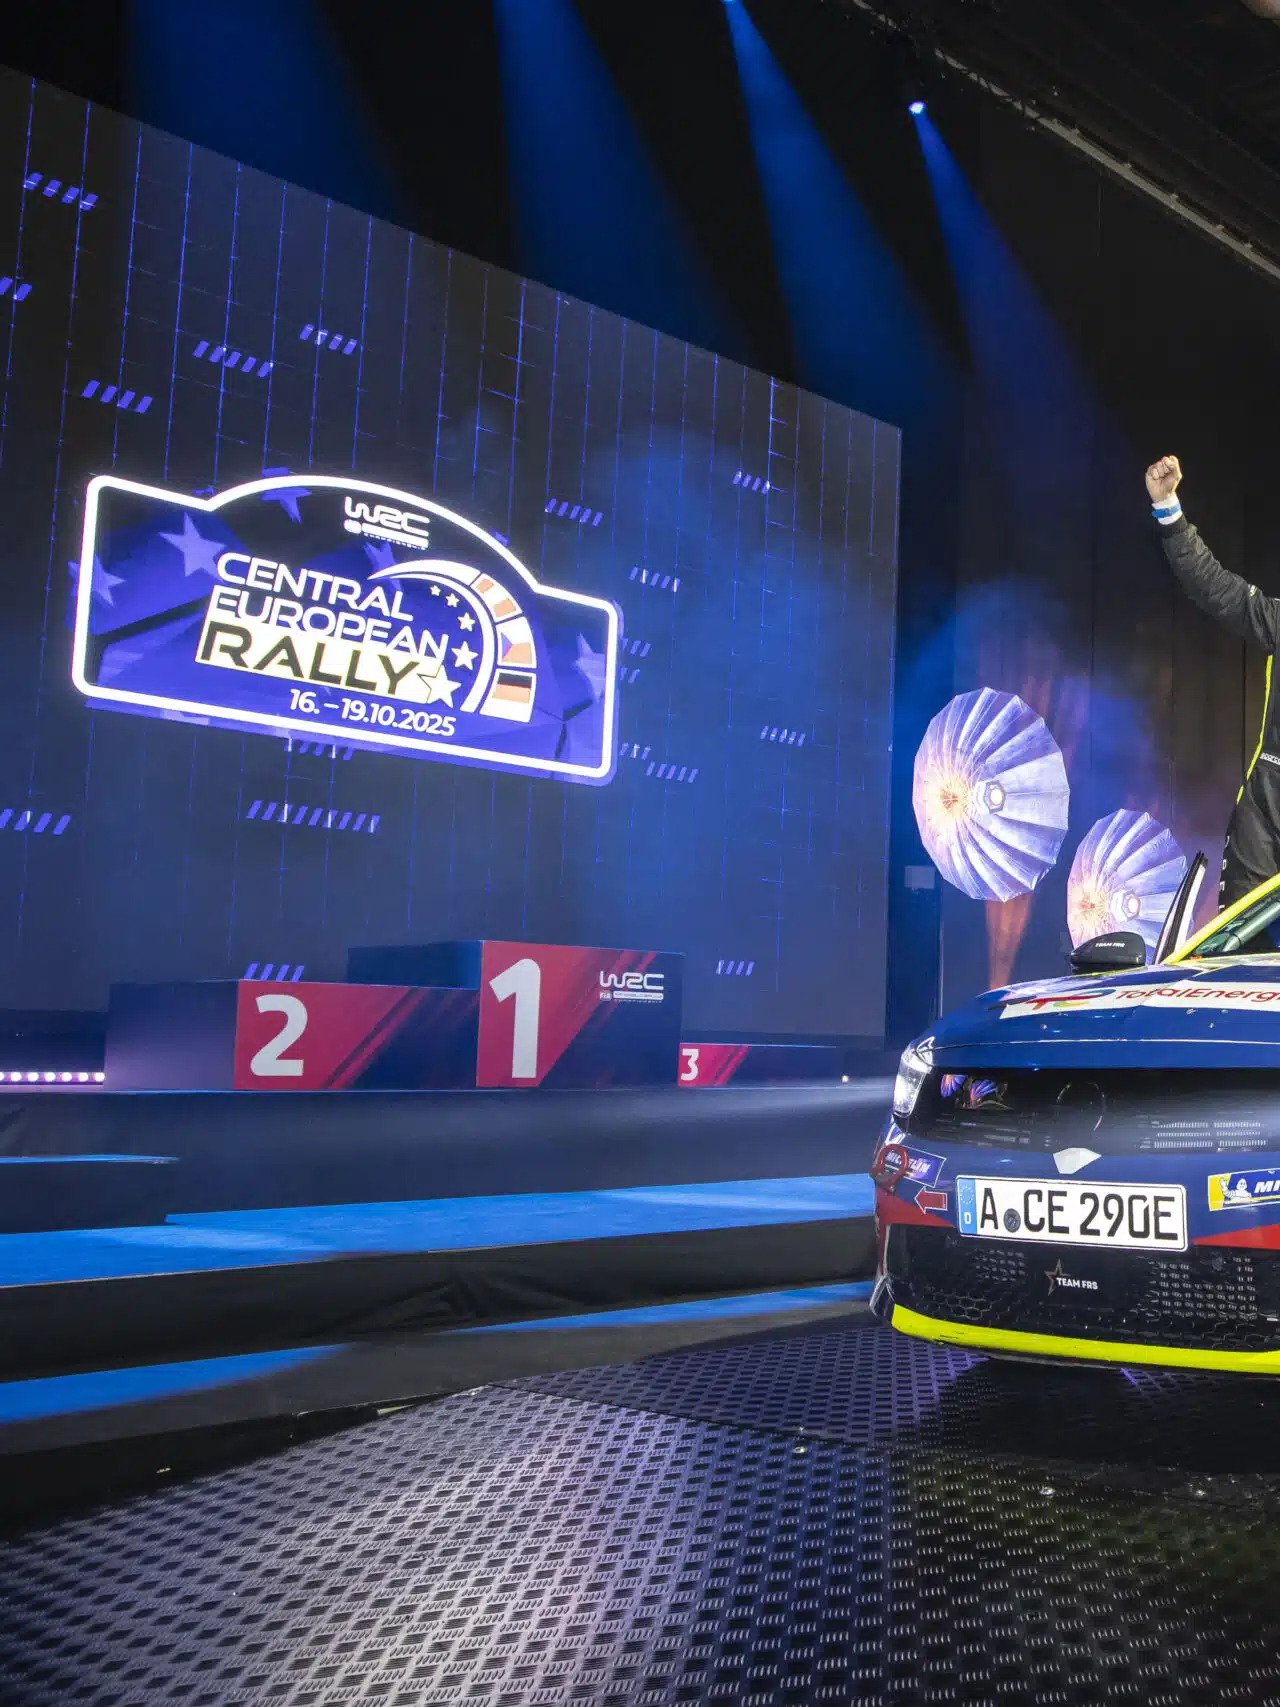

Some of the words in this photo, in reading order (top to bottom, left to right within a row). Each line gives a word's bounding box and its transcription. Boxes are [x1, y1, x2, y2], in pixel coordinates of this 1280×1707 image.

[344, 496, 430, 536] WRC
[217, 552, 414, 621] CENTRAL
[210, 585, 449, 662] EUROPEAN
[200, 620, 420, 695] RALLY
[599, 970, 665, 991] WRC
[249, 994, 309, 1077] 2
[489, 958, 541, 1079] 1
[680, 1048, 699, 1081] 3
[963, 1212, 972, 1225] D
[979, 1187, 999, 1230] A
[1023, 1188, 1070, 1235] CE
[1079, 1192, 1179, 1241] 290E
[1056, 1276, 1081, 1288] TEAM
[1081, 1280, 1098, 1290] FRS
